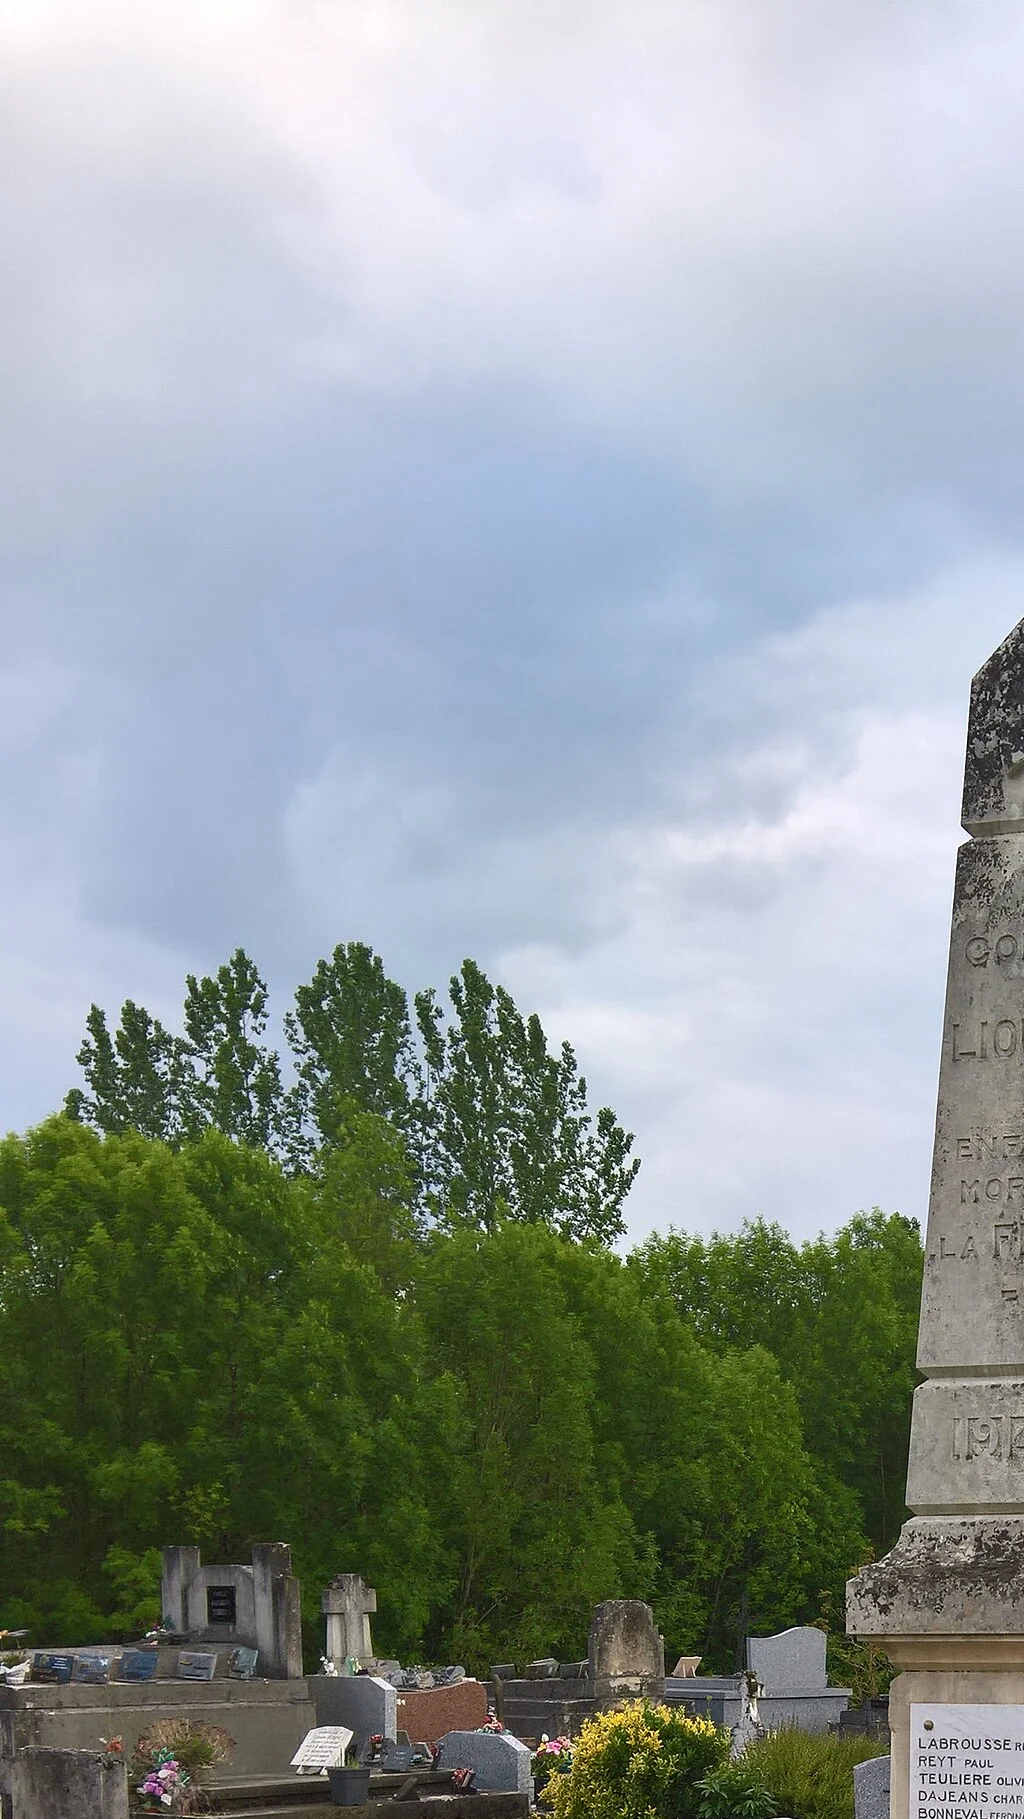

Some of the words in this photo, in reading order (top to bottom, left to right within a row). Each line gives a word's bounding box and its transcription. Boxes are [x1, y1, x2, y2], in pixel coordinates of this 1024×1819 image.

[939, 1236, 979, 1260] LA
[918, 1738, 1012, 1750] LABROUSSE
[918, 1756, 956, 1767] REYT
[965, 1759, 994, 1768] PAUL
[919, 1773, 992, 1785] TEULIERE
[918, 1790, 989, 1803] DAJEANS
